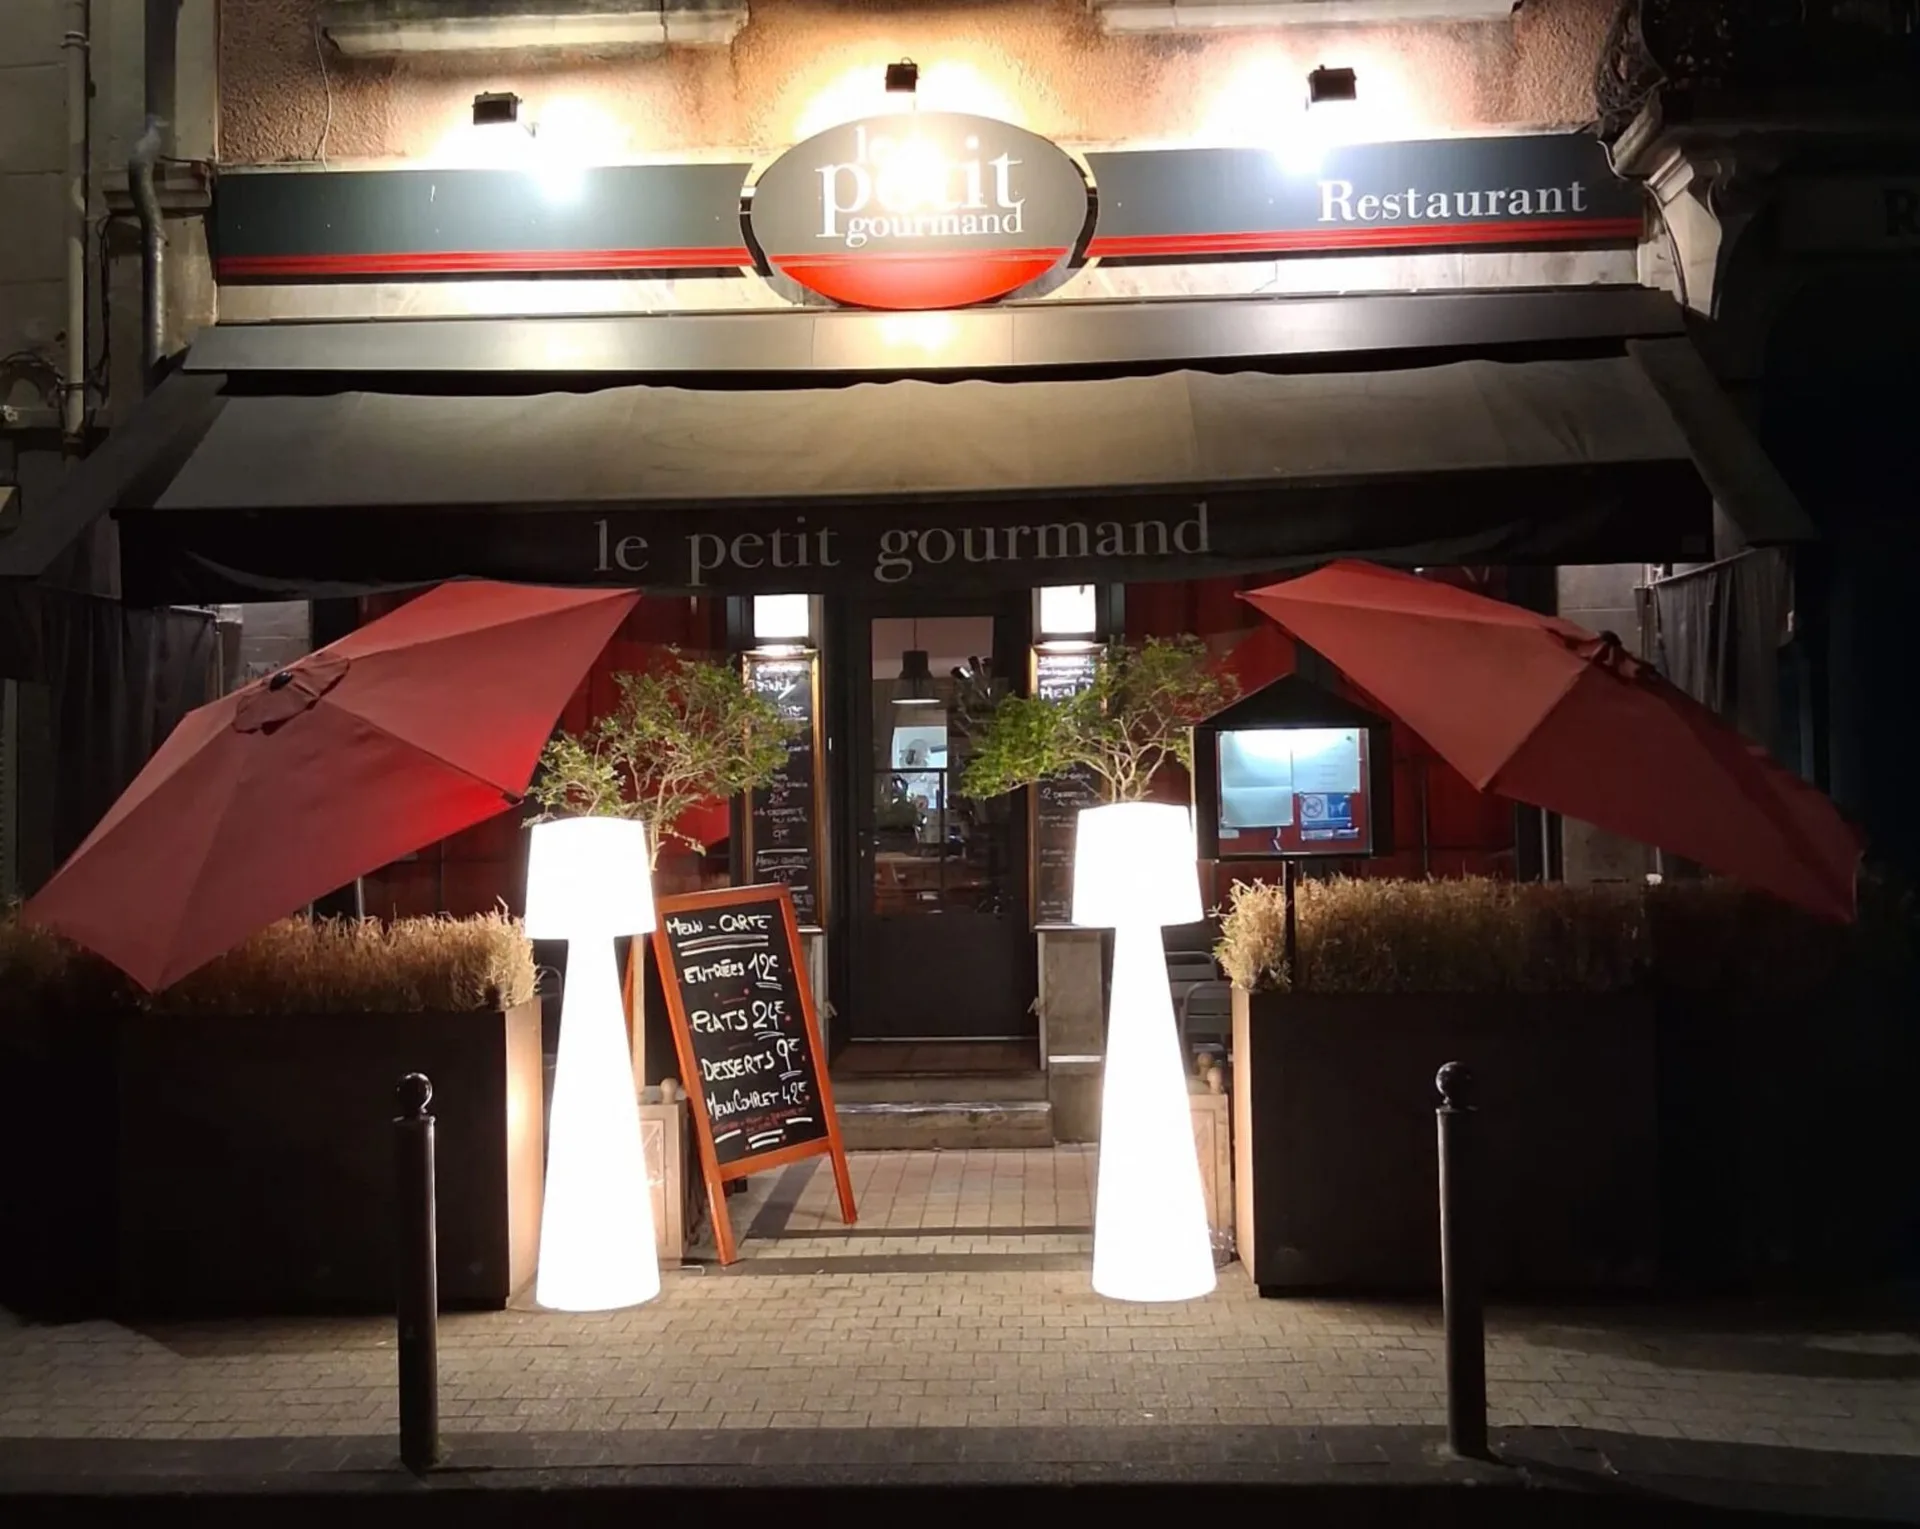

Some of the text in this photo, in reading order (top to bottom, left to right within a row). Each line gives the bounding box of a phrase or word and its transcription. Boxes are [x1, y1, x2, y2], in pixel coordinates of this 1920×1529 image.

[814, 135, 1026, 238] peit
[1317, 180, 1589, 222] Restaurant
[845, 203, 1025, 248] gourmand
[593, 501, 1214, 587] le petit gourmand
[691, 1010, 748, 1033] PLATS
[701, 1050, 776, 1082] DESSERTS
